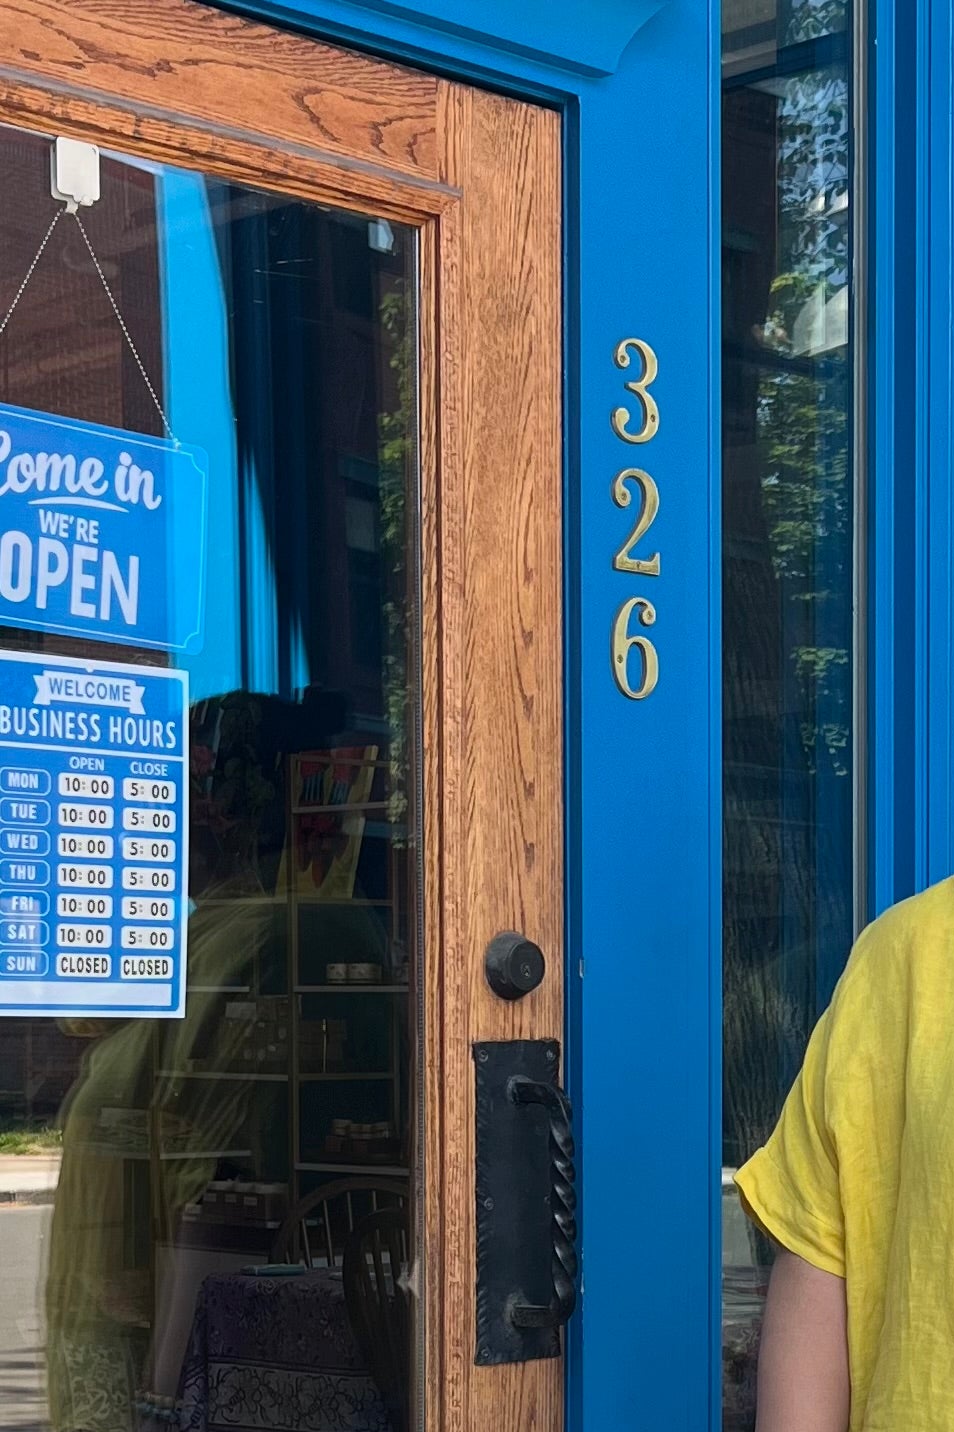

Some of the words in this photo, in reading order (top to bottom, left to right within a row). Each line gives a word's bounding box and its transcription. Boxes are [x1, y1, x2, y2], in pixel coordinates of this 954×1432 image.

[114, 451, 162, 510] in
[38, 509, 99, 544] WE'RE
[610, 338, 661, 700] 326
[0, 530, 140, 626] OPEN
[49, 677, 131, 702] WELCOME
[0, 705, 101, 742] BUSINESS
[108, 715, 177, 749] HOURS
[69, 756, 105, 771] OPEN
[130, 761, 168, 776] CLOSE
[8, 772, 38, 789] MON
[10, 803, 37, 819] TUE
[7, 833, 38, 850] WED
[9, 864, 36, 880] THU
[11, 895, 34, 911] FRI
[7, 924, 36, 940] SAT
[6, 956, 36, 972] SUN
[60, 957, 108, 974] CLOSED
[123, 959, 169, 976] CLOSED
